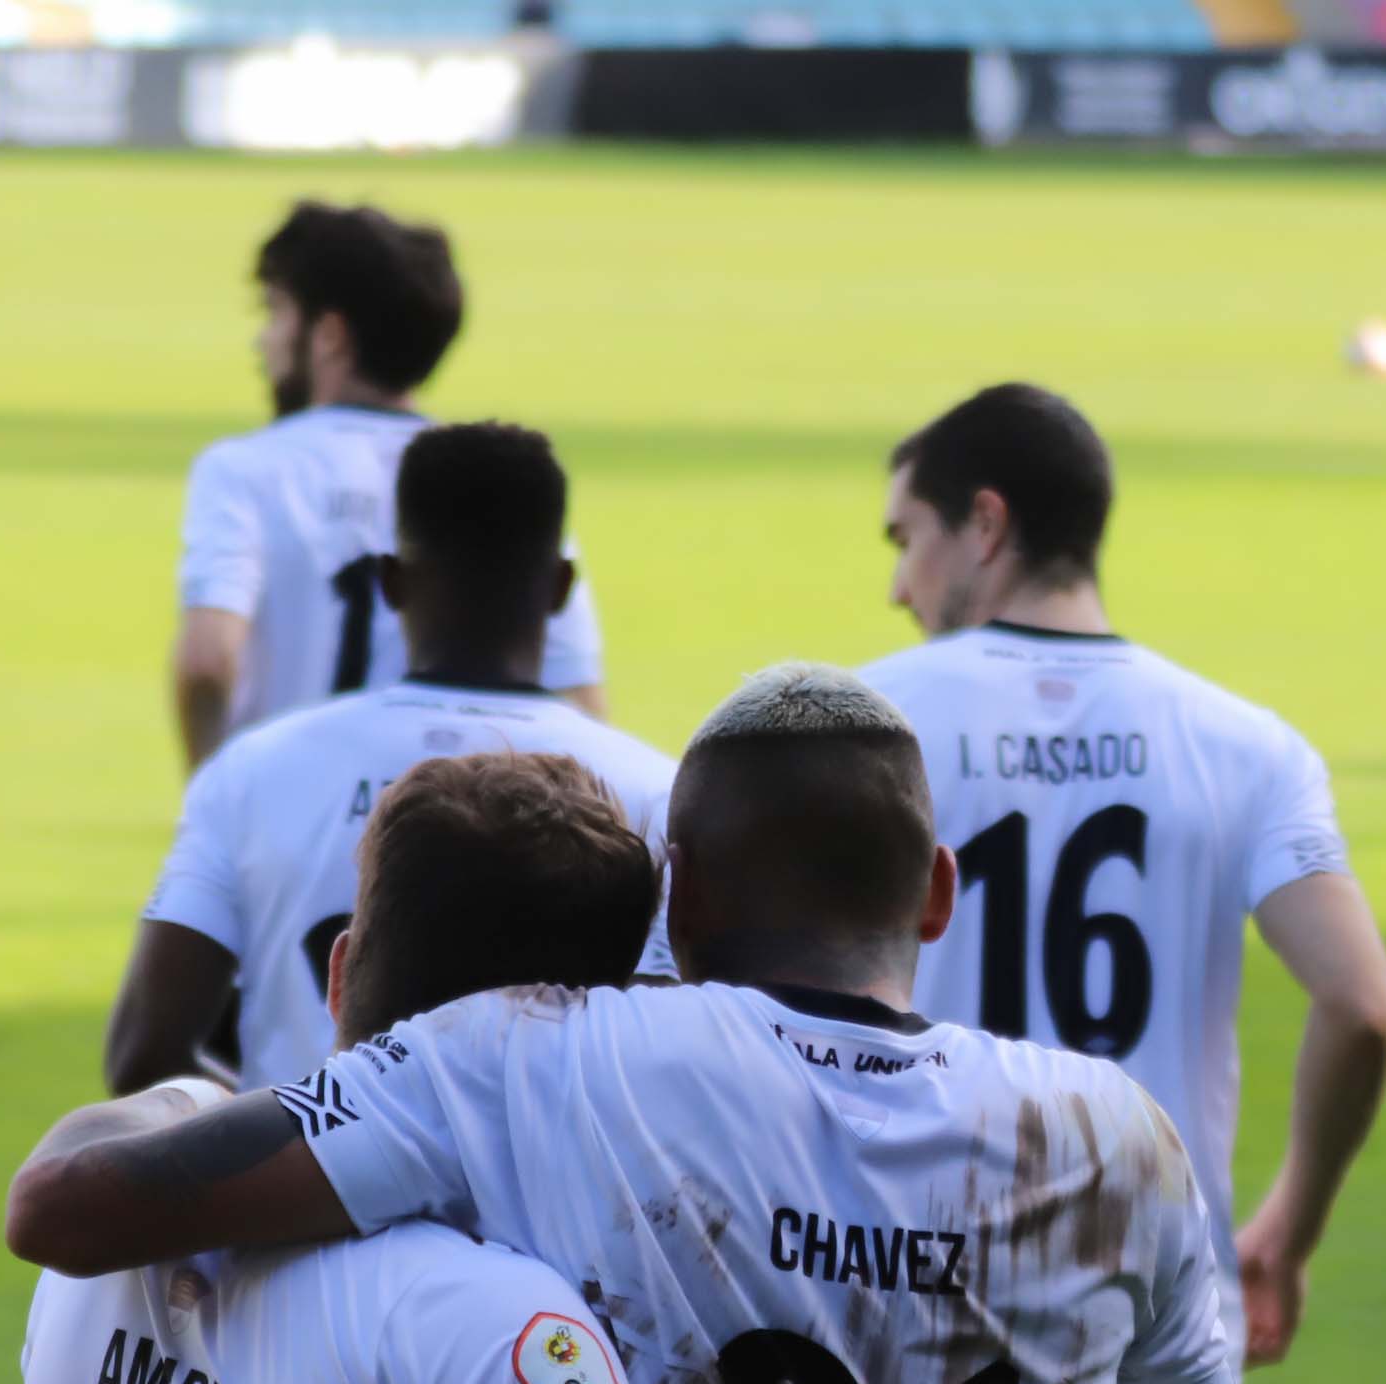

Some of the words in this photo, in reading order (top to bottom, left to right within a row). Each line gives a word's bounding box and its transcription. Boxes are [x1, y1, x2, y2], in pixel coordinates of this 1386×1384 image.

[958, 734, 984, 779] I.
[996, 733, 1147, 785] CASADO
[956, 804, 1153, 1062] 16
[770, 1207, 966, 1296] CHAVEZ
